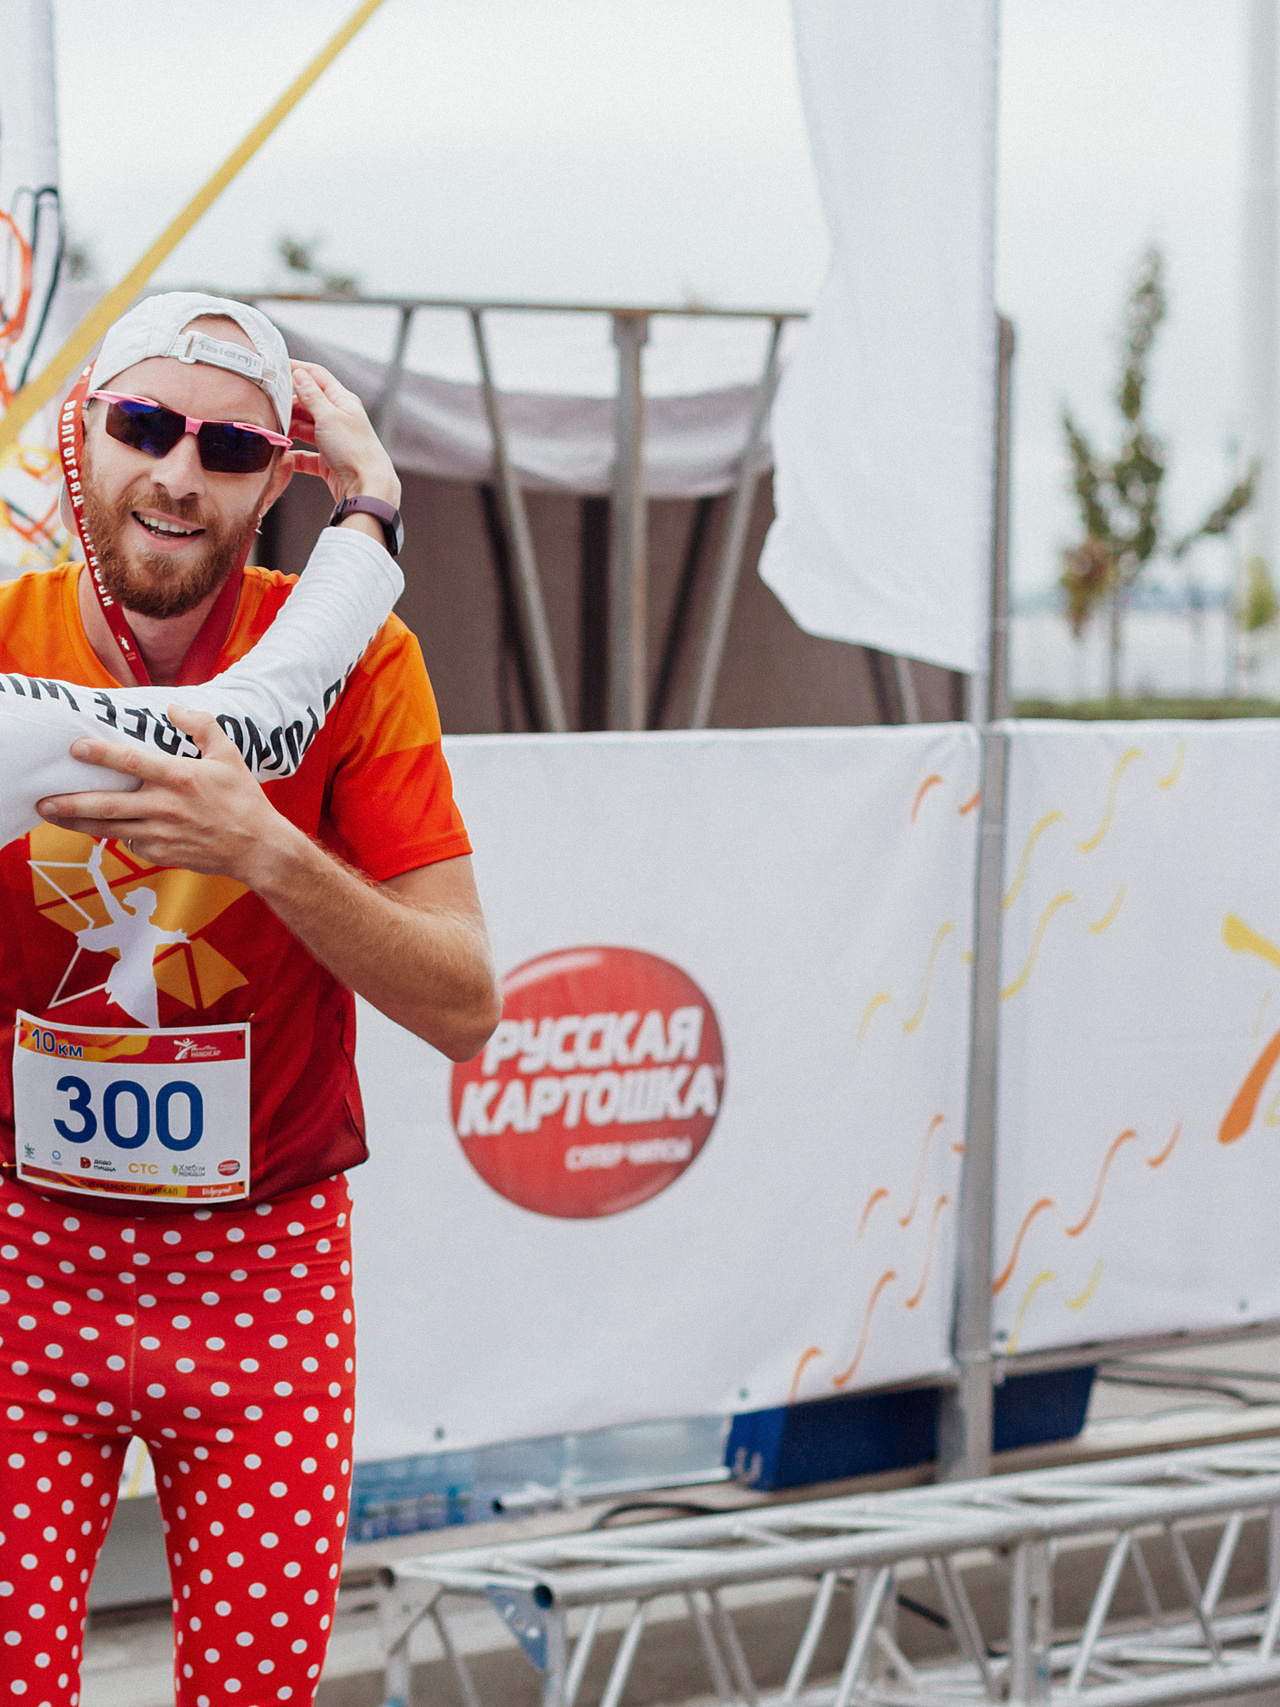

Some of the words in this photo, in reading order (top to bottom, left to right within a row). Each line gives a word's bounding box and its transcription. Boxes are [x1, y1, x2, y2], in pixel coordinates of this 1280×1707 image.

[61, 400, 85, 509] ВОЛГОГРАД
[31, 1028, 56, 1053] 10
[481, 1005, 704, 1075] РУССКАЯ
[53, 1075, 204, 1152] 300
[457, 1064, 719, 1138] КАРТОШКА
[79, 1179, 137, 1193] ПОЛУМАРАФОН
[138, 1185, 178, 1195] ГАНДИКАП
[128, 1162, 159, 1175] СТС
